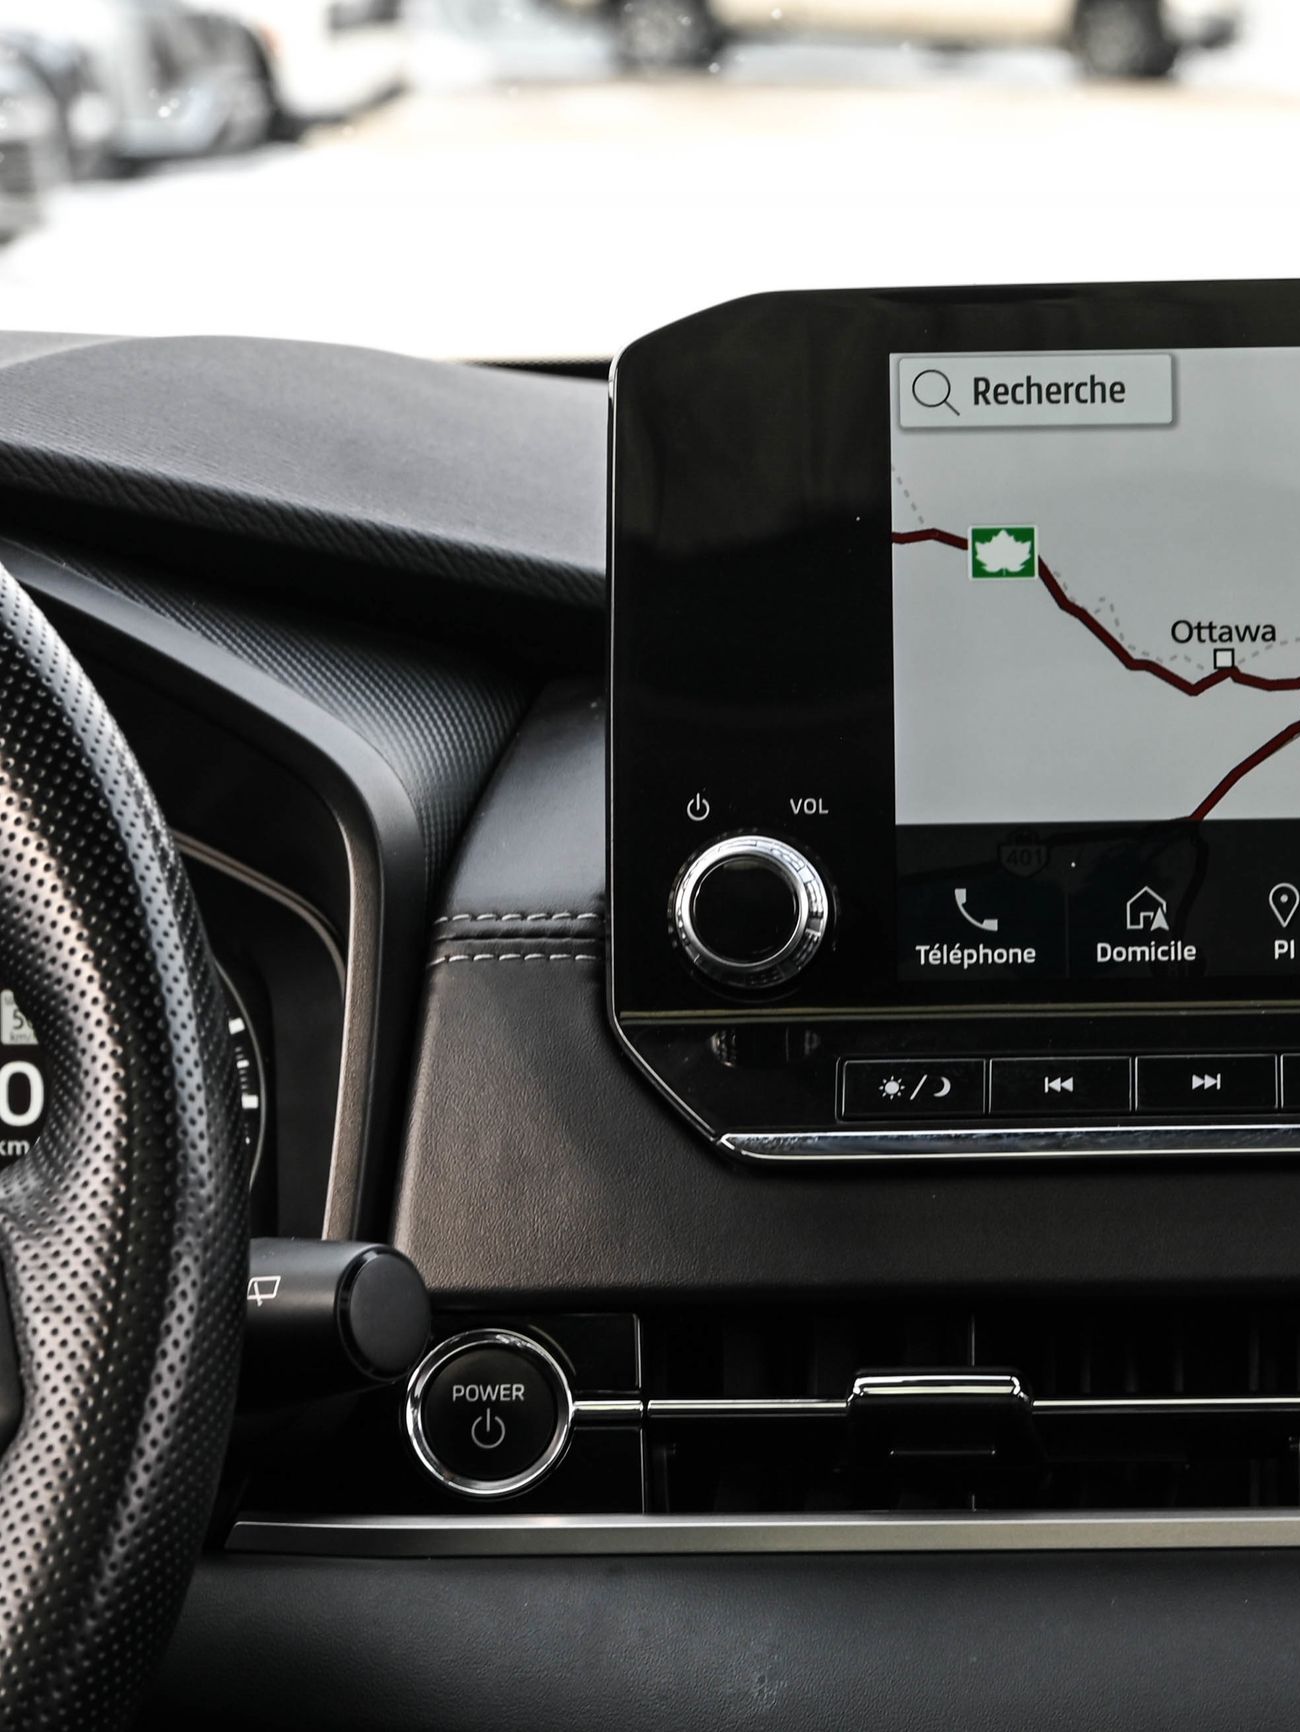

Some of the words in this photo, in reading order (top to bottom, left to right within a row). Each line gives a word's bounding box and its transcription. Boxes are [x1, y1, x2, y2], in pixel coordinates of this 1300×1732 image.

[972, 374, 1127, 407] Recherche
[1170, 619, 1277, 645] Ottawa
[789, 798, 830, 815] VOL
[915, 942, 1037, 970] Téléphone
[1096, 940, 1198, 963] Domicile
[1273, 939, 1296, 961] PI
[452, 1382, 526, 1403] POWER
